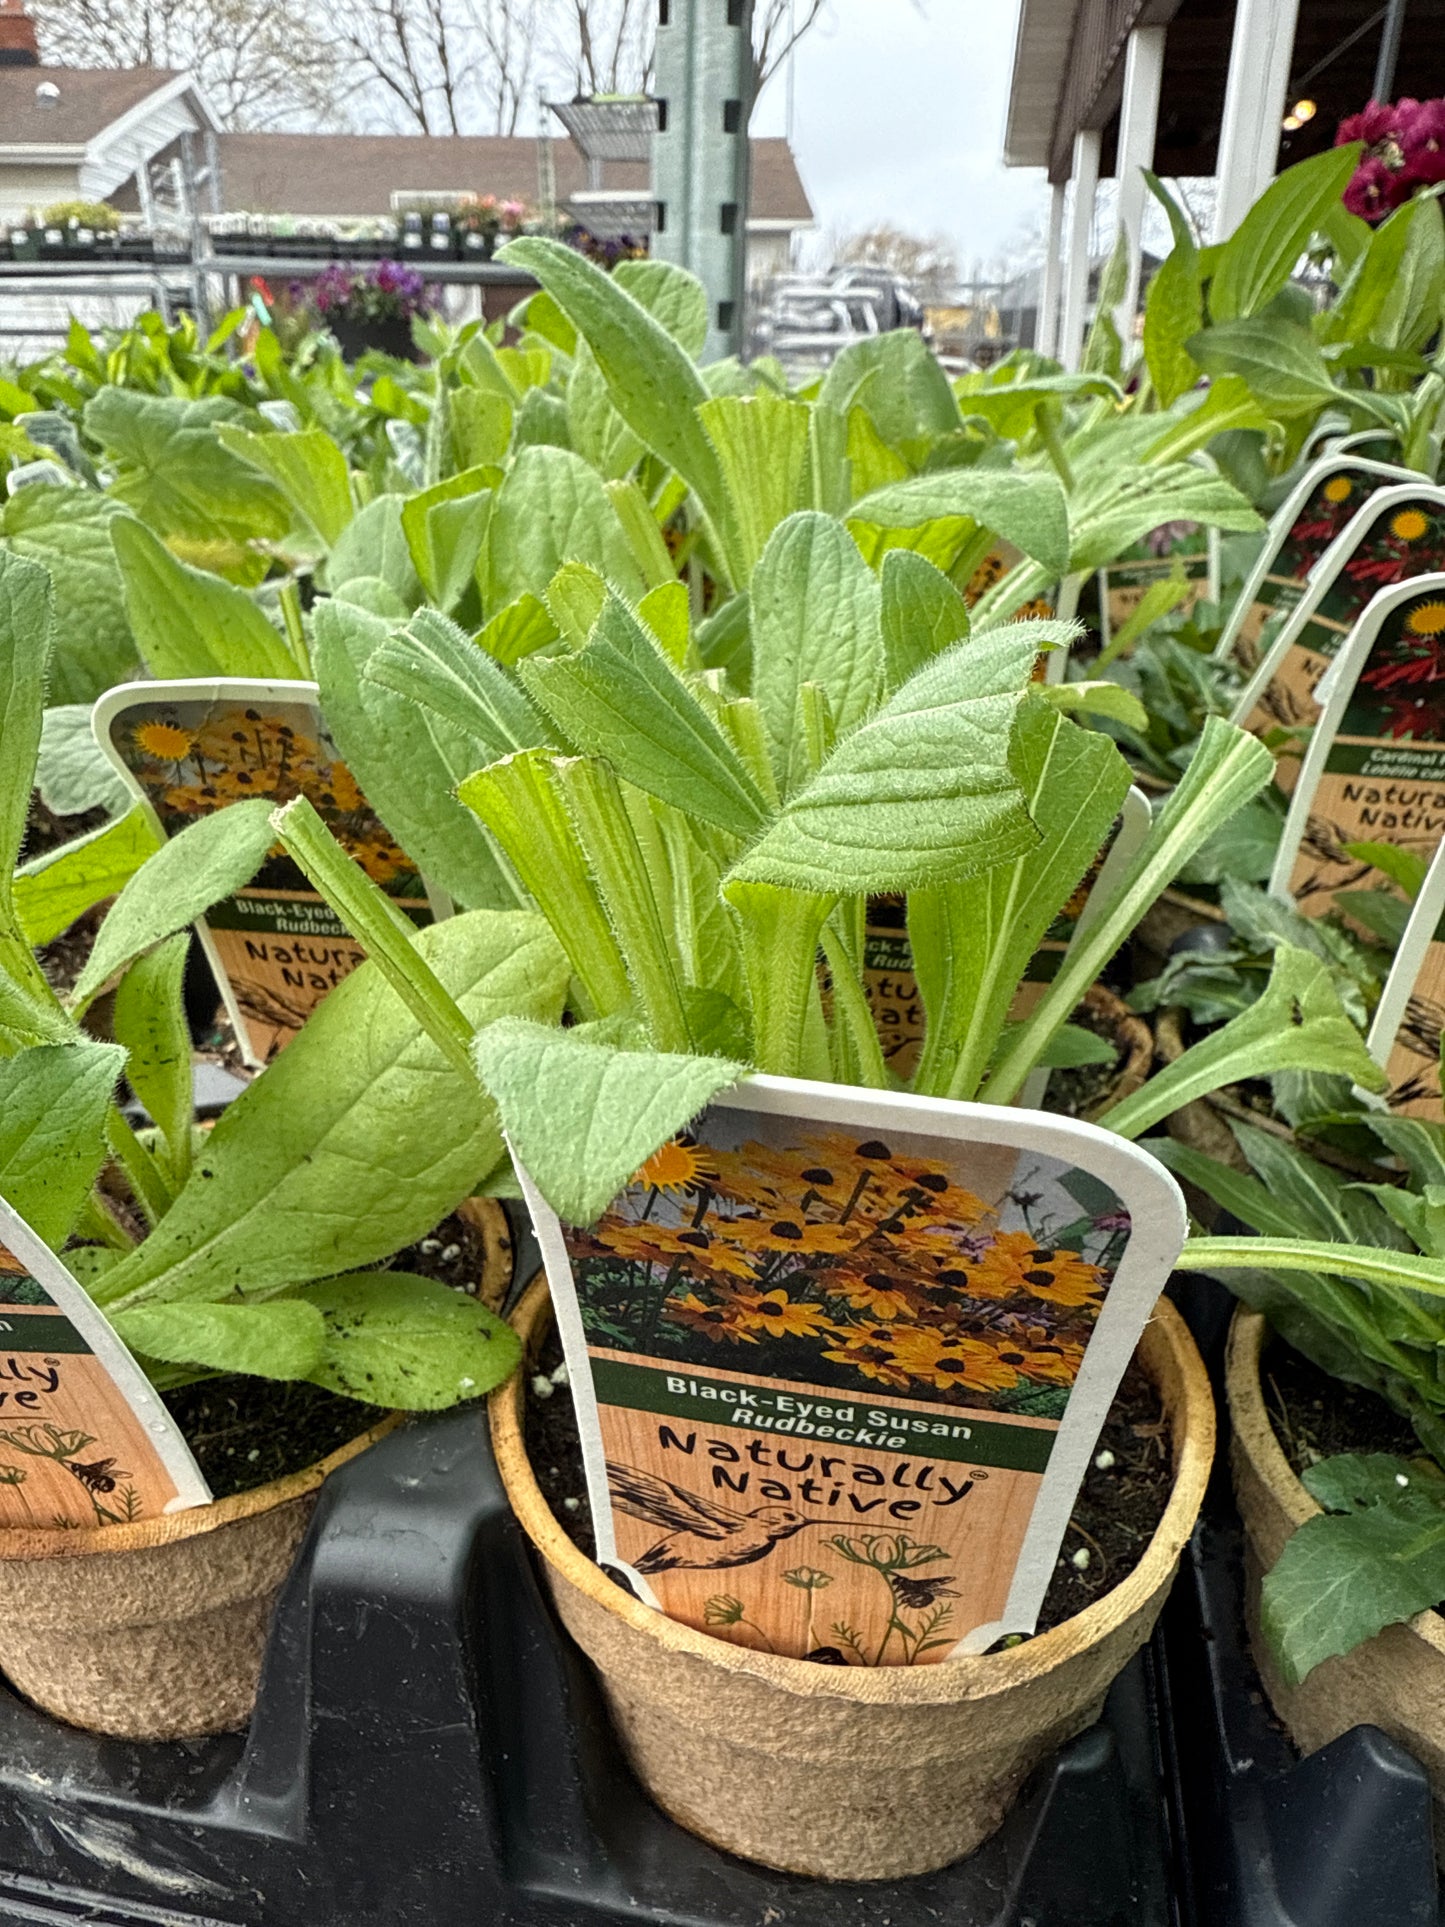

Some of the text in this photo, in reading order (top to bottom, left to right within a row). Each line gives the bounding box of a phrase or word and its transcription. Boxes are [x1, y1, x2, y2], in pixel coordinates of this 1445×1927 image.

[1361, 808, 1445, 831] Nativ
[236, 901, 335, 920] Black-Eyed
[282, 967, 350, 990] Nat
[666, 1376, 973, 1440] Black-Eyed Susan
[731, 1408, 907, 1449] Rudbeckie
[659, 1425, 974, 1507] Naturally
[712, 1465, 922, 1521] Native
